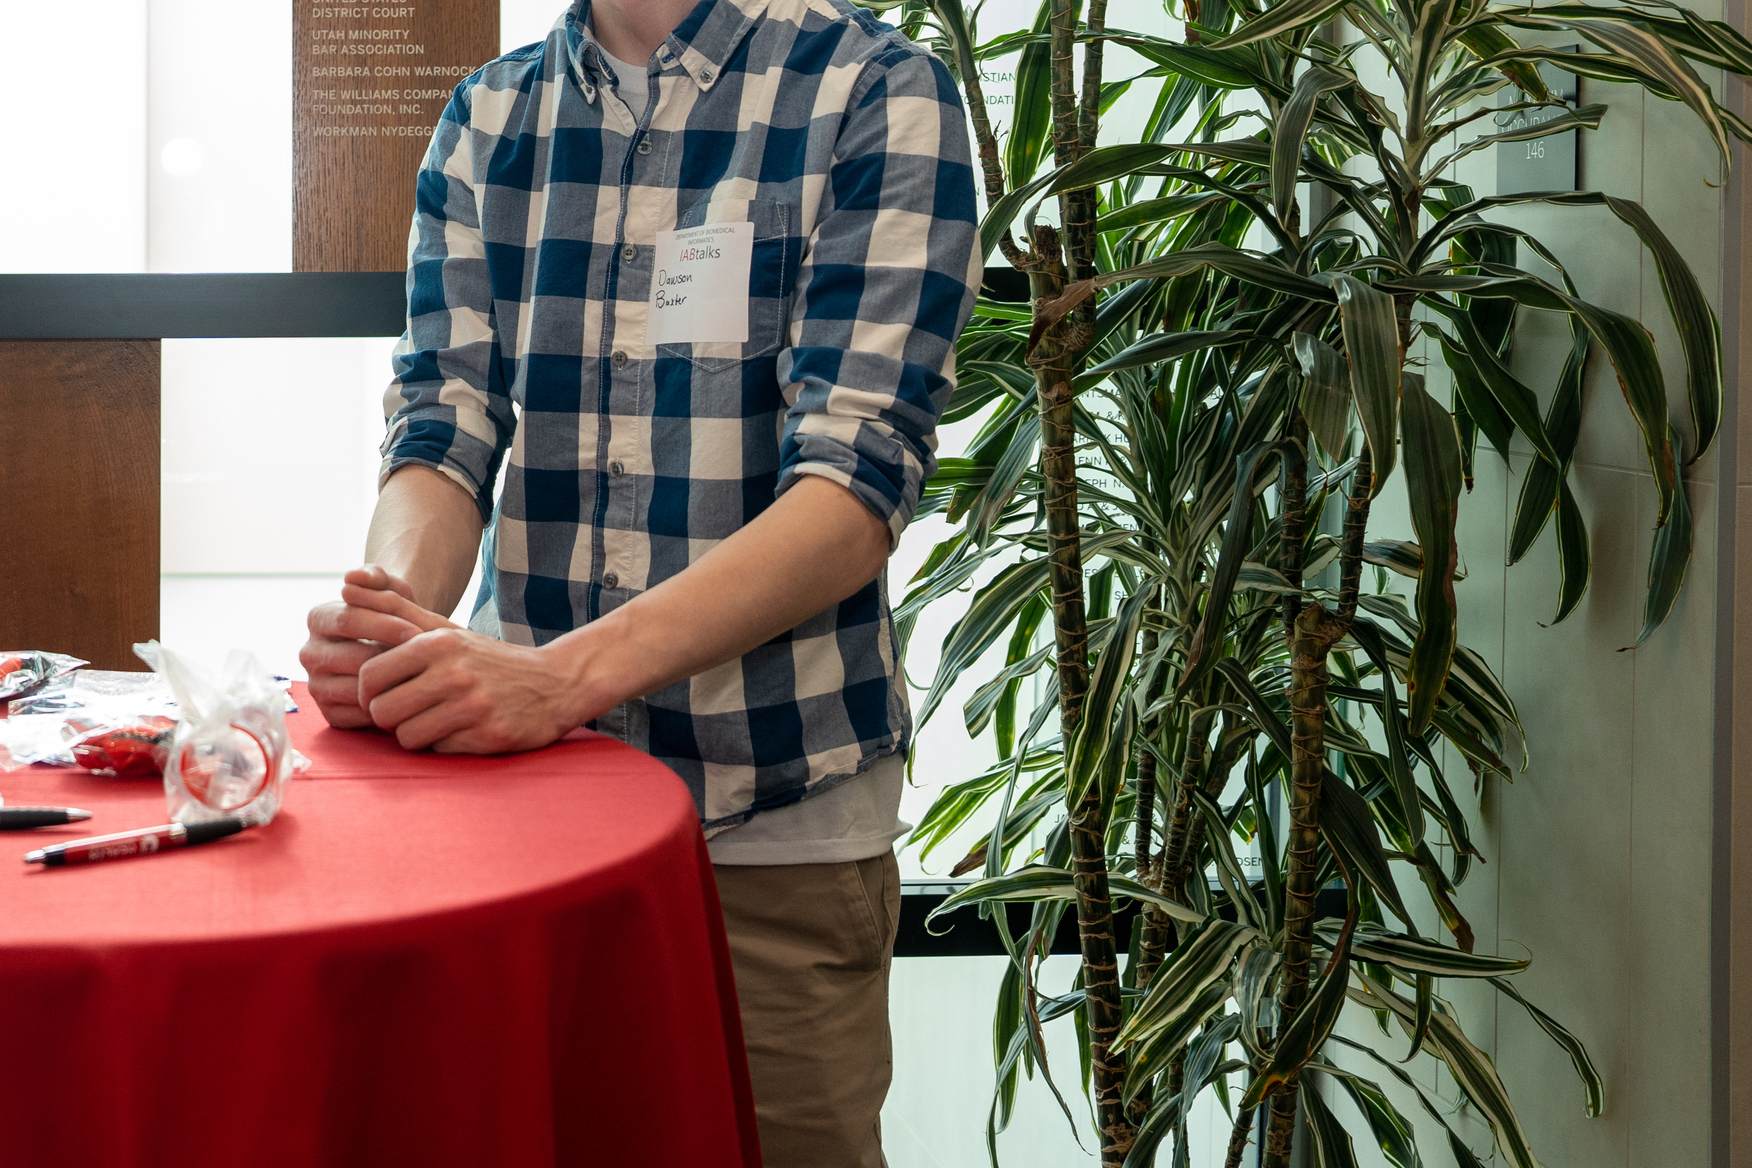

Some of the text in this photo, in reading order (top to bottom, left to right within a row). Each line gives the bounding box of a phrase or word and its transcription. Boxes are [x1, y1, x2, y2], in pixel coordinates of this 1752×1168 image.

[312, 8, 415, 18] DISTRICT COURT
[312, 30, 410, 40] UTAH MINORITY
[312, 44, 424, 55] BAR ASSOCIATION
[312, 66, 370, 77] BARBARA
[374, 67, 410, 76] COHN
[312, 104, 424, 115] FOUNDATION, INC.
[1526, 141, 1545, 159] 146
[705, 227, 735, 235] BIOMEDICAL
[679, 245, 721, 262] IABtalks
